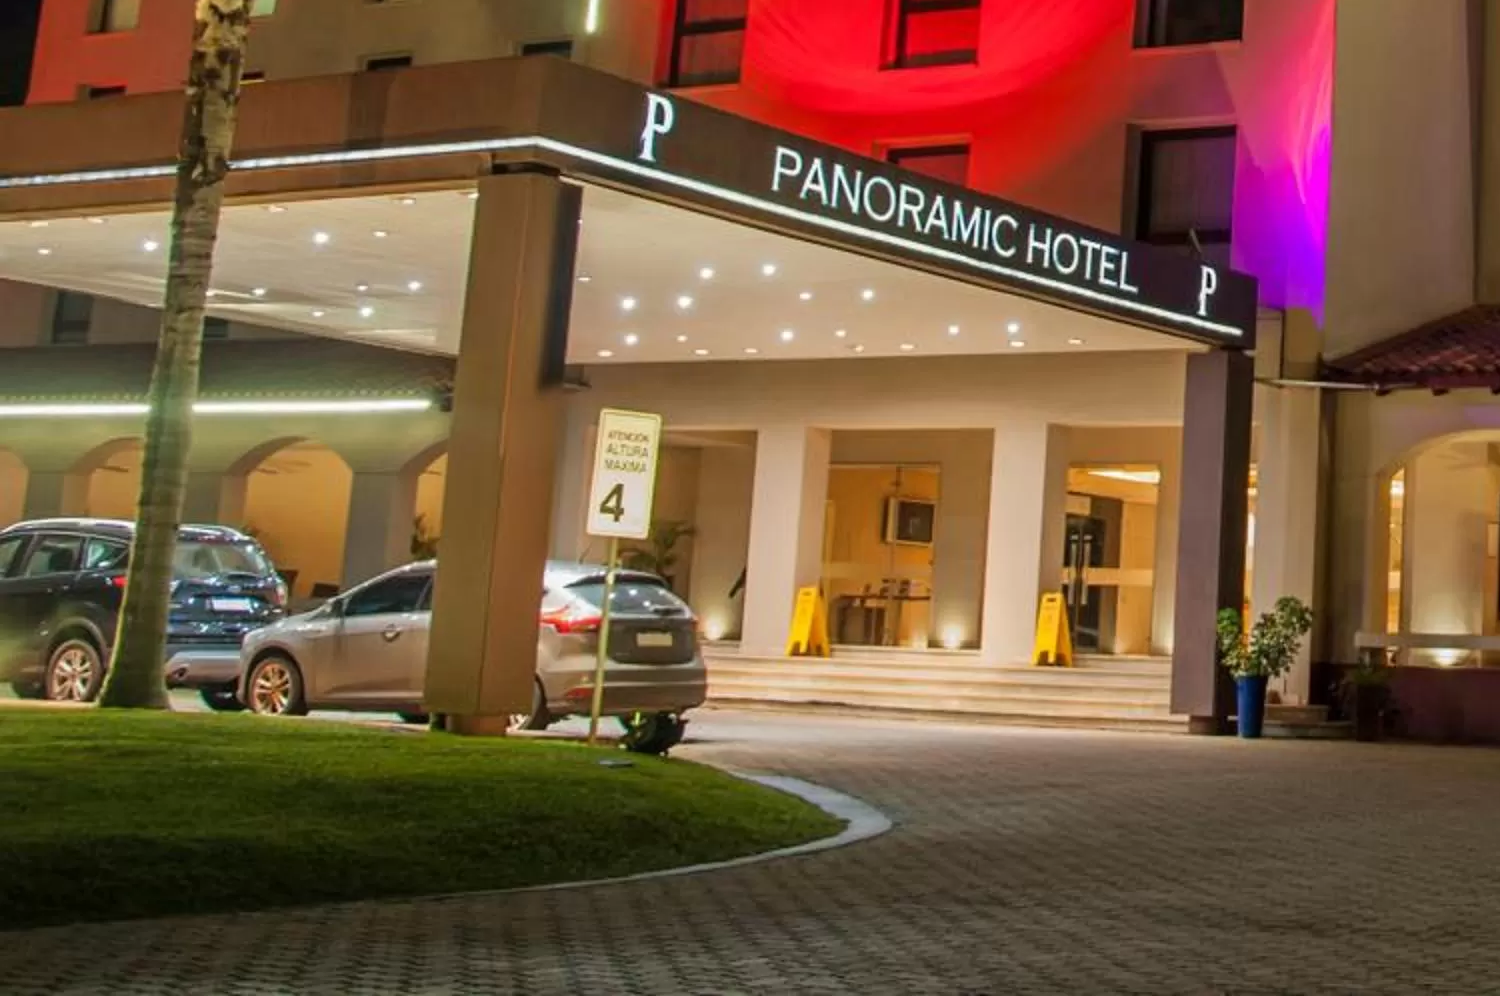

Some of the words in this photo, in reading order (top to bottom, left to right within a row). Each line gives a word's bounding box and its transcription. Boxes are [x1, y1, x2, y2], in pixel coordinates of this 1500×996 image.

[640, 92, 674, 162] P
[771, 146, 1018, 258] PANORAMIC
[1026, 223, 1140, 294] HOTEL
[1196, 265, 1218, 316] P
[606, 443, 649, 457] ALTURA
[600, 483, 625, 523] 4
